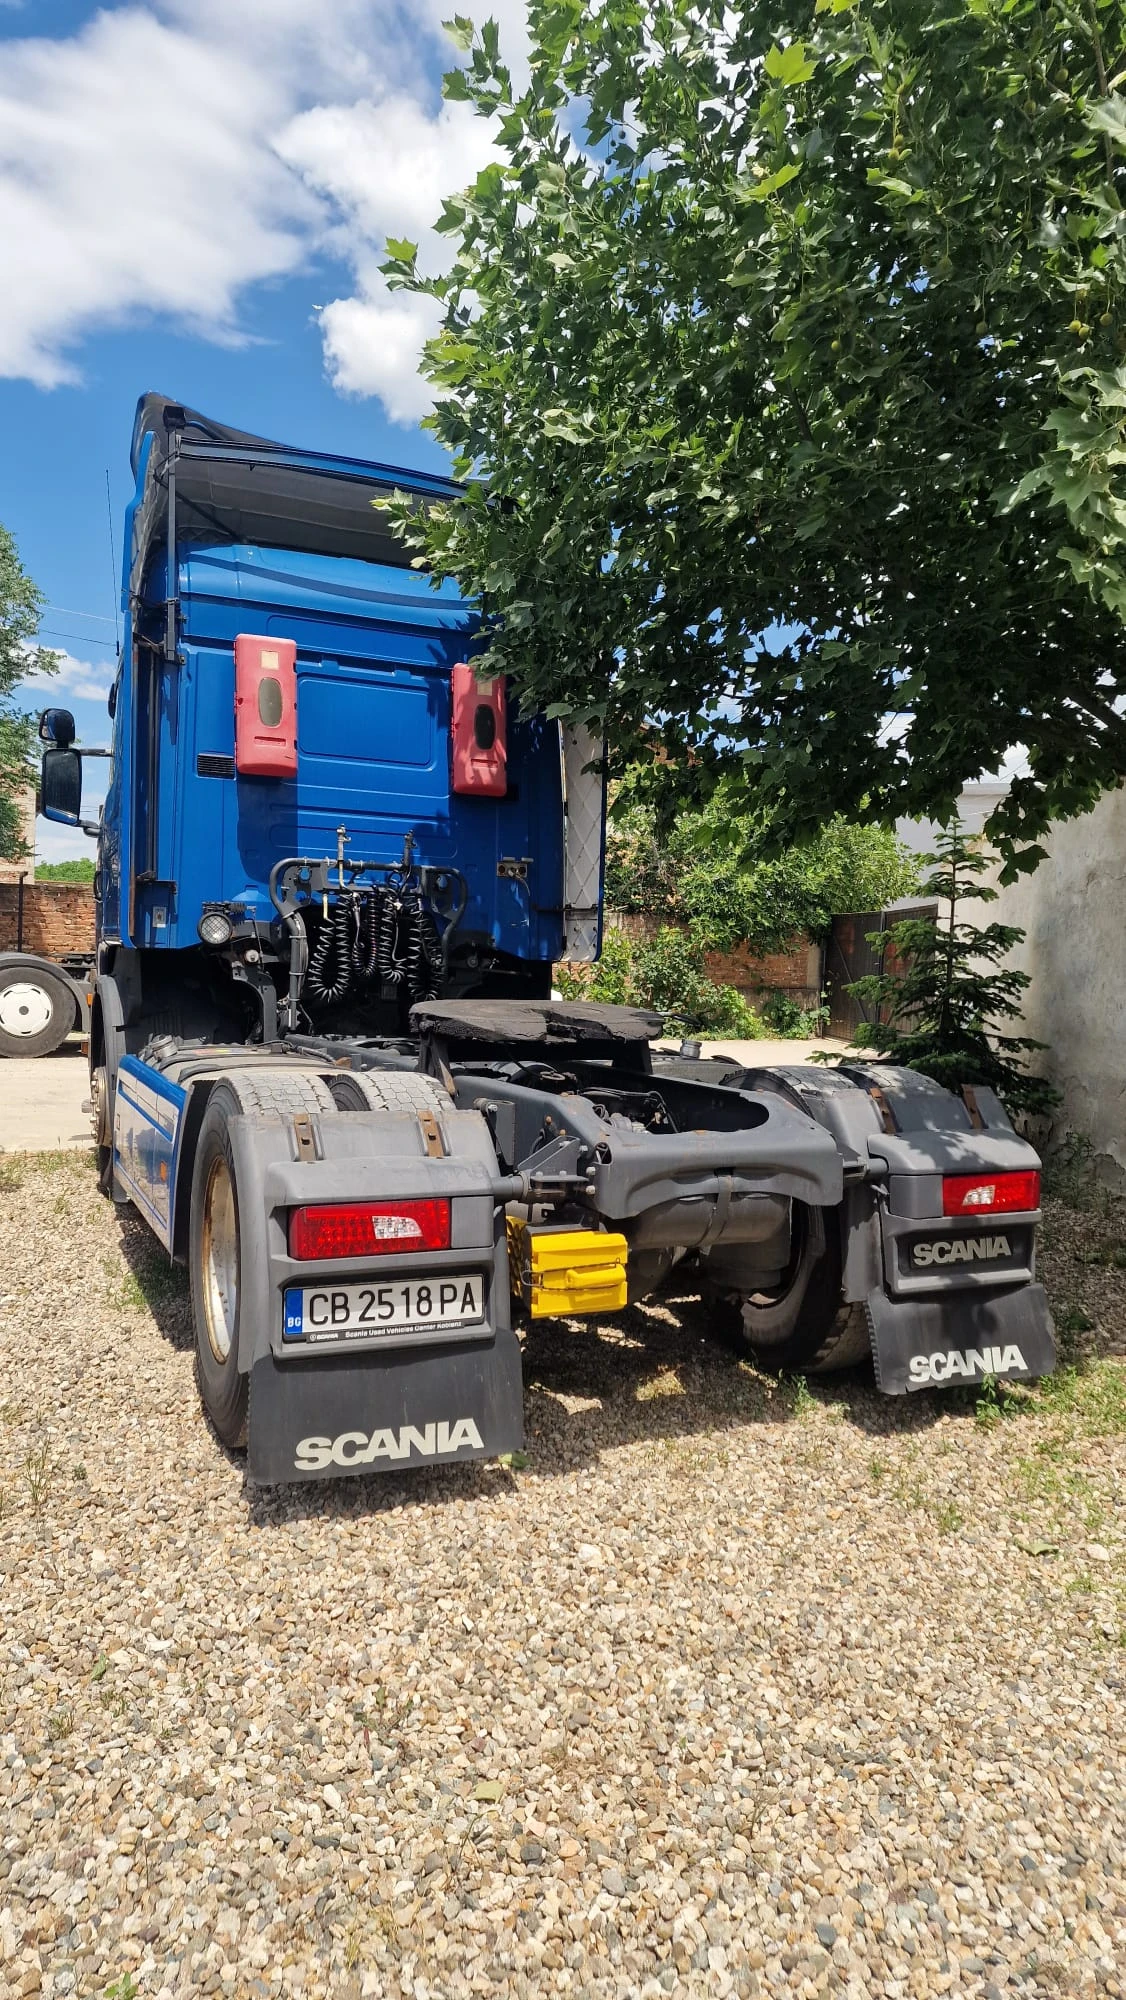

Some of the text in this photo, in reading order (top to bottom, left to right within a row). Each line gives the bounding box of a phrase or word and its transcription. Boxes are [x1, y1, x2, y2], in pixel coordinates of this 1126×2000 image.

[913, 1236, 1012, 1266] SCANIA
[287, 1317, 301, 1327] BG
[345, 1330, 368, 1338] Scania
[369, 1328, 386, 1336] Used
[387, 1326, 413, 1334] Vehicles
[908, 1344, 1028, 1383] SCANIA
[294, 1417, 484, 1470] SCANIA
